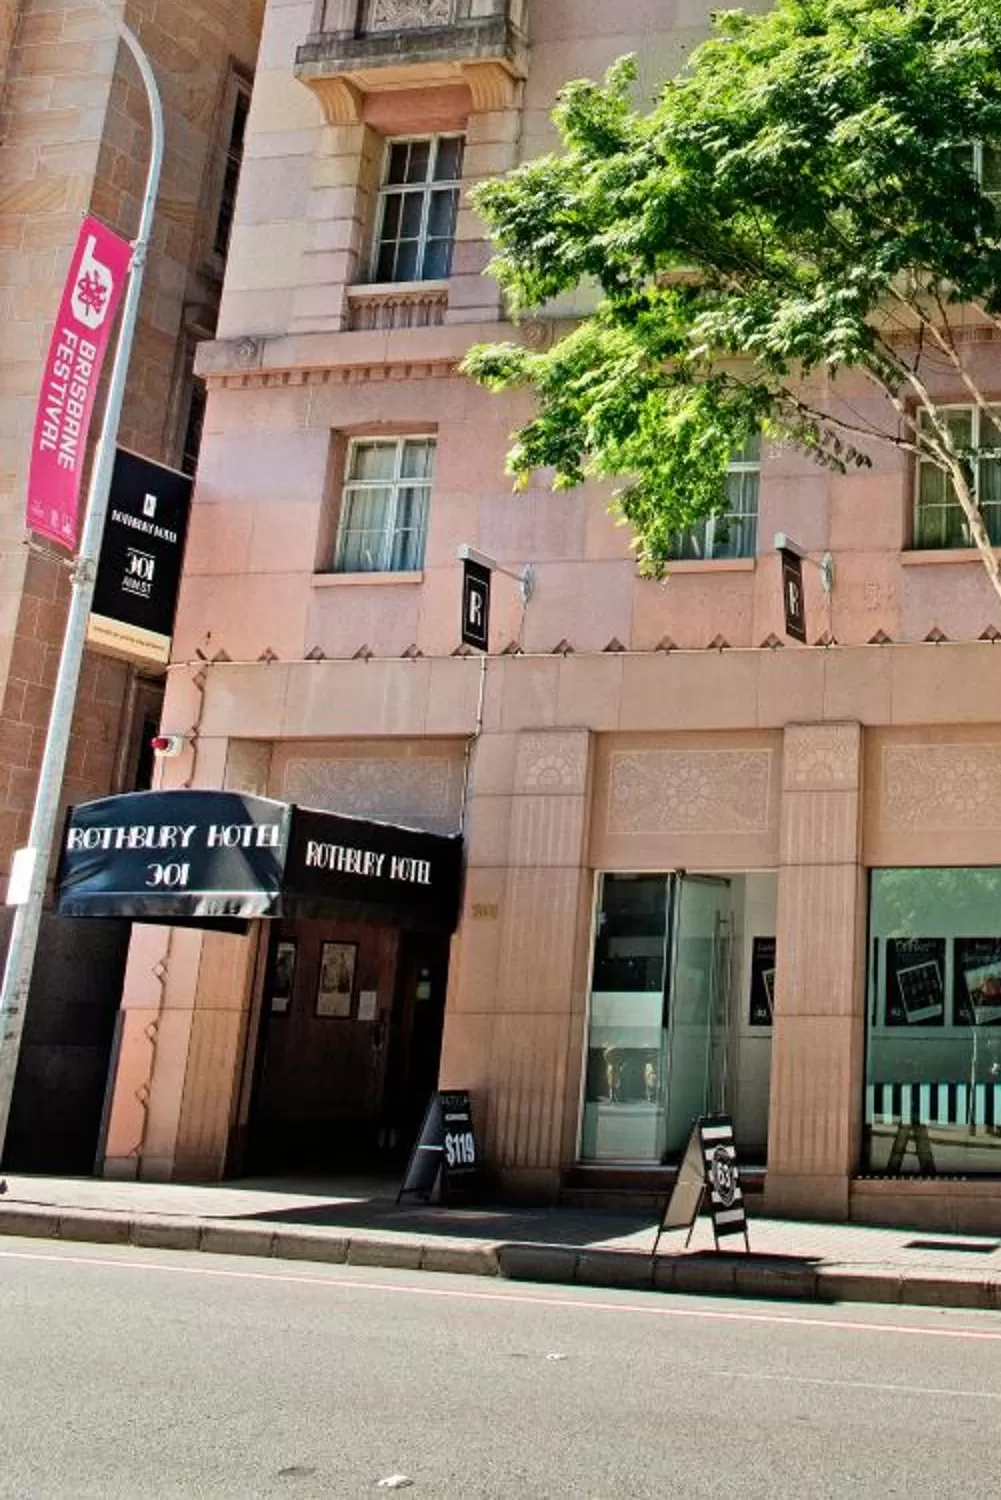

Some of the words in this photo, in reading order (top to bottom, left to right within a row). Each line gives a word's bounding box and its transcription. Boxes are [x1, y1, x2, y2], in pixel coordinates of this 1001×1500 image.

[40, 328, 78, 451] FESTIVAL
[57, 339, 96, 471] BRISBANE
[125, 552, 155, 581] 301
[470, 591, 482, 626] R
[67, 825, 196, 850] ROTHBURY
[207, 824, 282, 848] HOTEL
[145, 863, 190, 887] 301
[305, 840, 386, 877] ROTHBURY
[389, 855, 432, 884] HOTEL
[445, 1132, 475, 1167] $119
